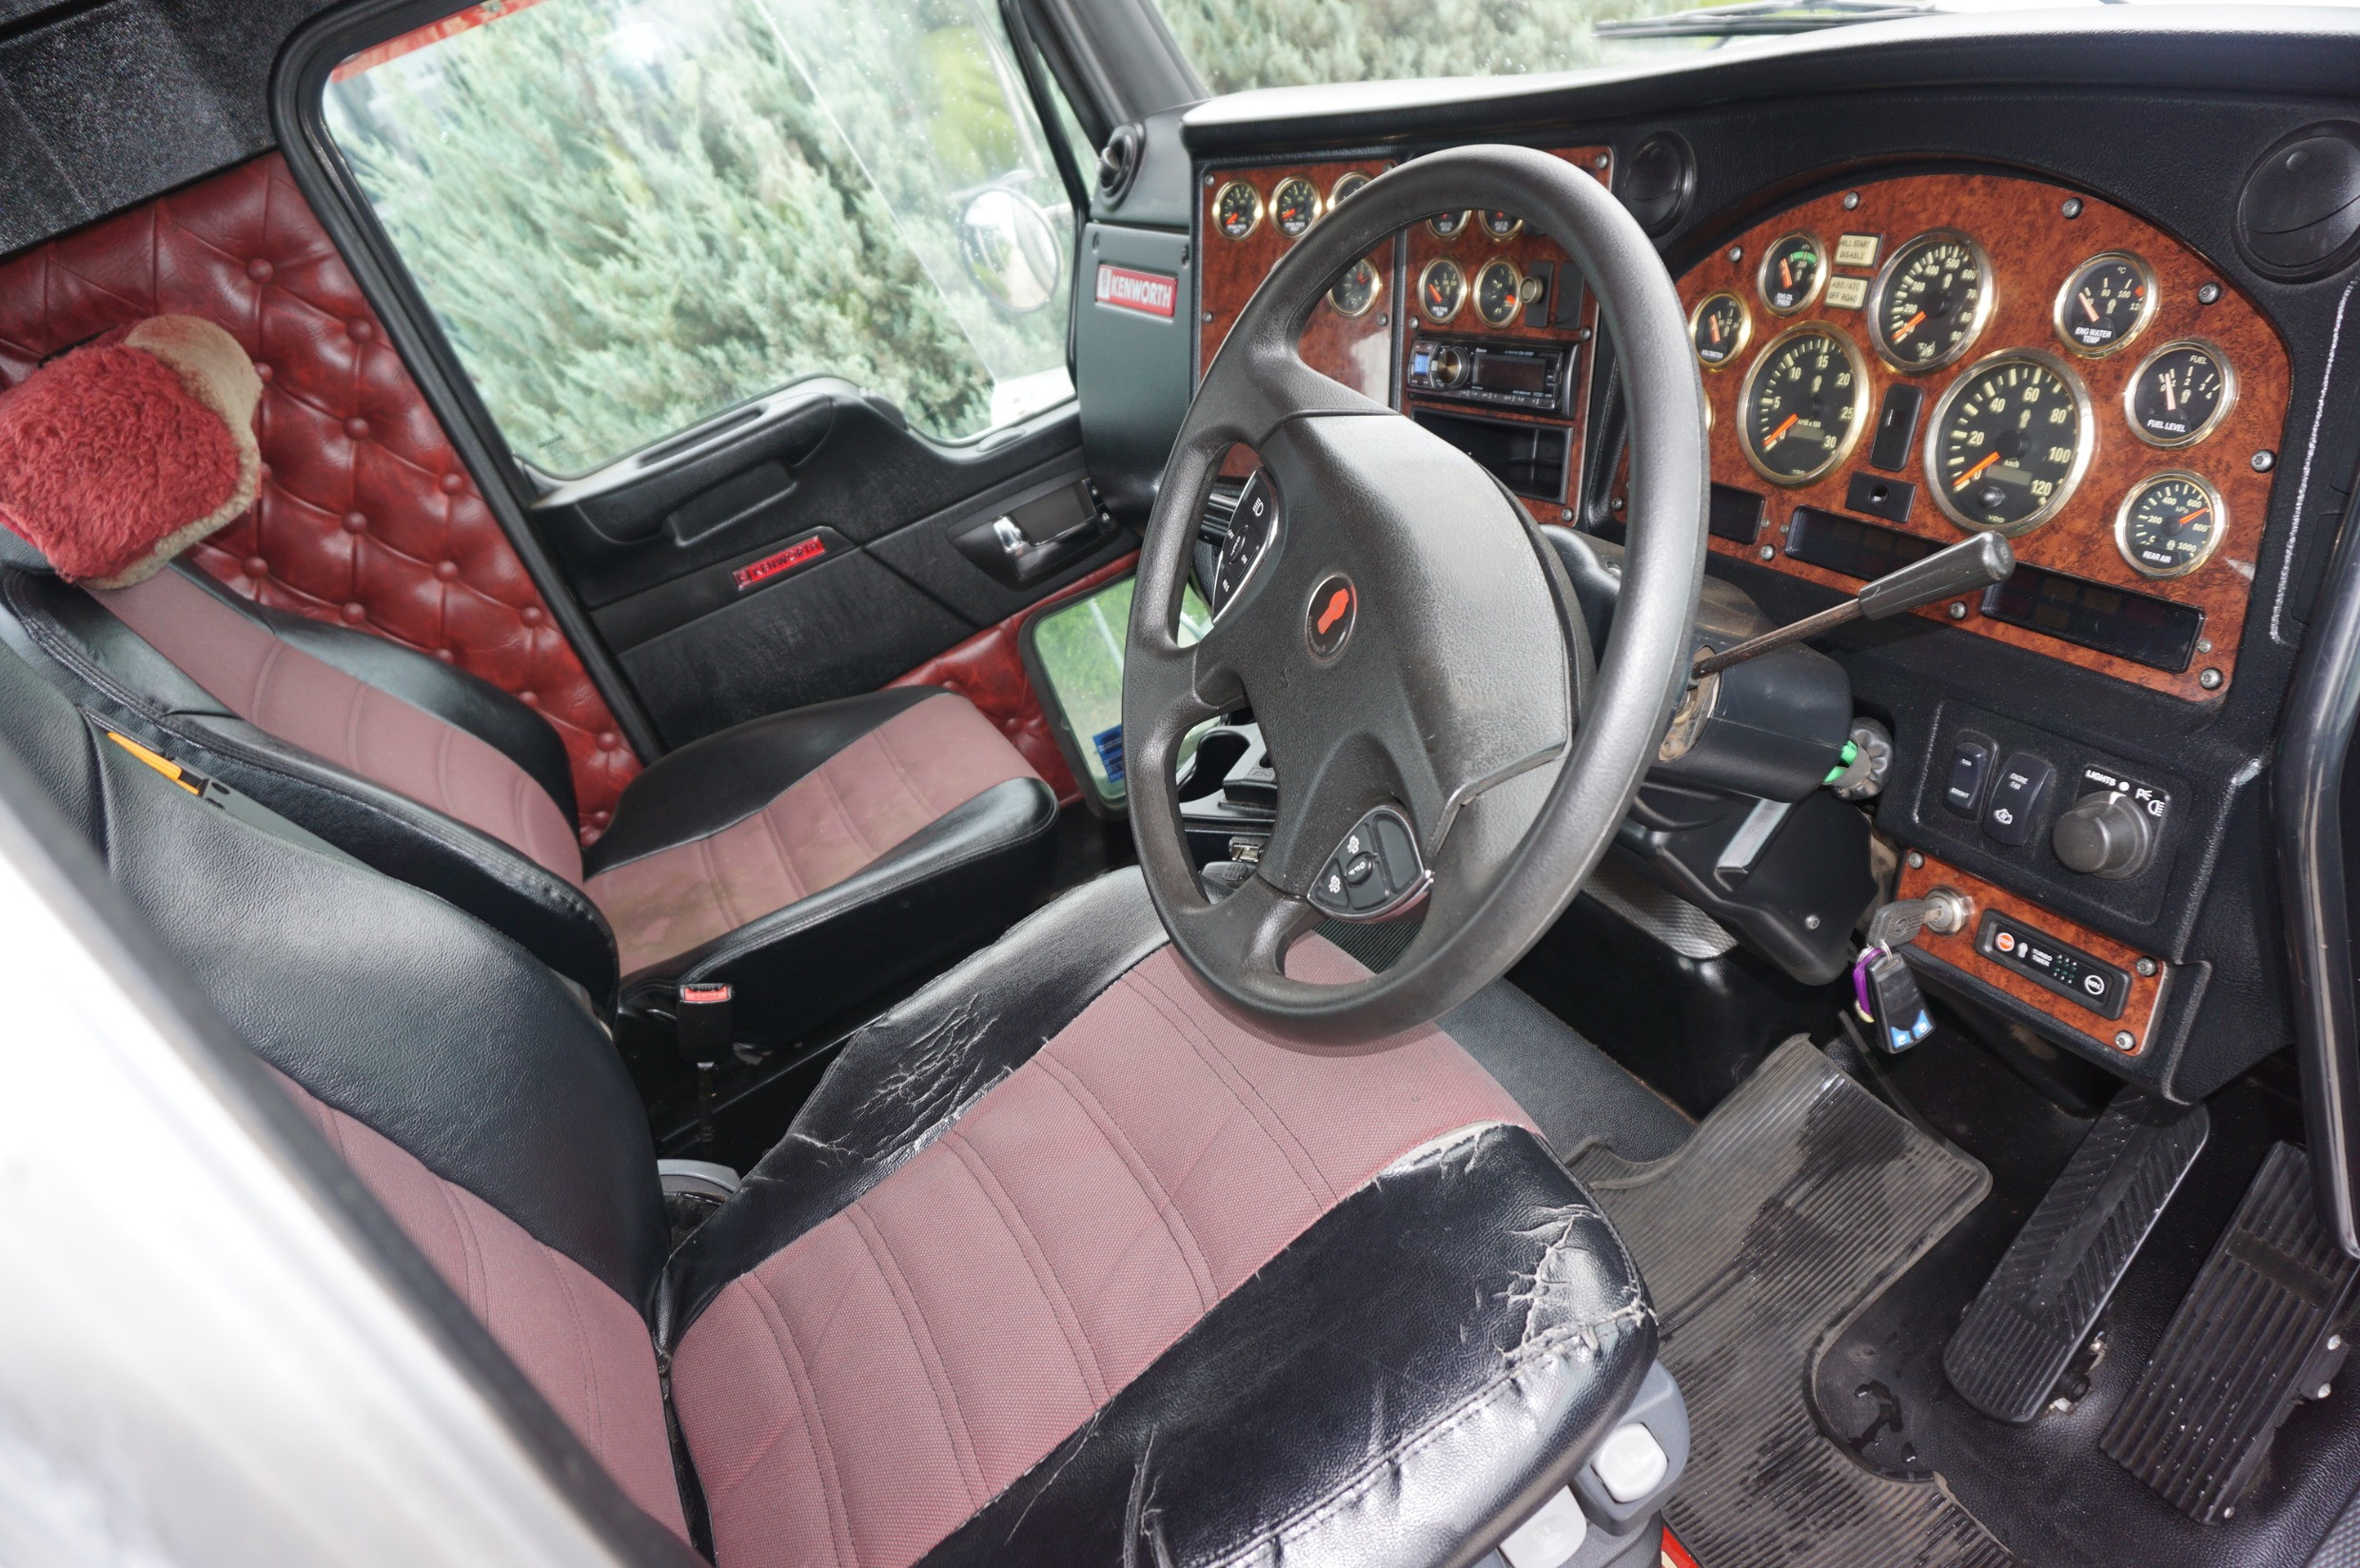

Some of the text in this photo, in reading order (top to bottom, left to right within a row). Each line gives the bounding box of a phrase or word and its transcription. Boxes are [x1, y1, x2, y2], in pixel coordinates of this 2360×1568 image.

[1839, 251, 1865, 260] DISABLE
[1946, 258, 1960, 268] 500
[1925, 265, 1940, 275] 400
[1111, 275, 1172, 307] KENWORTH
[1912, 282, 1926, 292] 300
[2117, 290, 2132, 299] 100
[1904, 304, 1918, 314] 200
[2075, 326, 2112, 339] ENG WATER
[2082, 335, 2101, 344] TEMP
[1818, 355, 1830, 368] 15
[2190, 354, 2208, 365] FUEL
[1790, 366, 1802, 381] 10
[1837, 372, 1851, 386] 20
[2159, 383, 2167, 392] 0
[2183, 378, 2191, 386] 2
[2198, 382, 2206, 391] 3
[2023, 386, 2040, 402] 60
[2205, 391, 2212, 400] 4
[1774, 396, 1781, 409] 5
[1991, 398, 2006, 412] 40
[1840, 406, 1854, 420] 25
[2050, 407, 2067, 424] 80
[2147, 419, 2187, 433] FUEL LEVEL
[1823, 435, 1838, 449] 30
[1968, 430, 1985, 447] 20
[2049, 446, 2072, 463] 100
[2004, 459, 2020, 469] km/h
[2032, 480, 2053, 497] 120
[2161, 497, 2177, 506] 400
[2186, 499, 2202, 508] 600
[2175, 505, 2189, 514] kPa
[1988, 515, 2005, 523] VDO
[2147, 515, 2163, 524] 200
[2193, 522, 2208, 533] 800
[2177, 541, 2197, 552] 1000
[752, 541, 819, 577] KENWORTH
[2142, 550, 2172, 563] REAR AIR
[2085, 769, 2117, 787] LIGHTS
[2009, 780, 2022, 791] FAN
[2032, 948, 2053, 962] TURBO
[2032, 953, 2051, 968] TIMER
